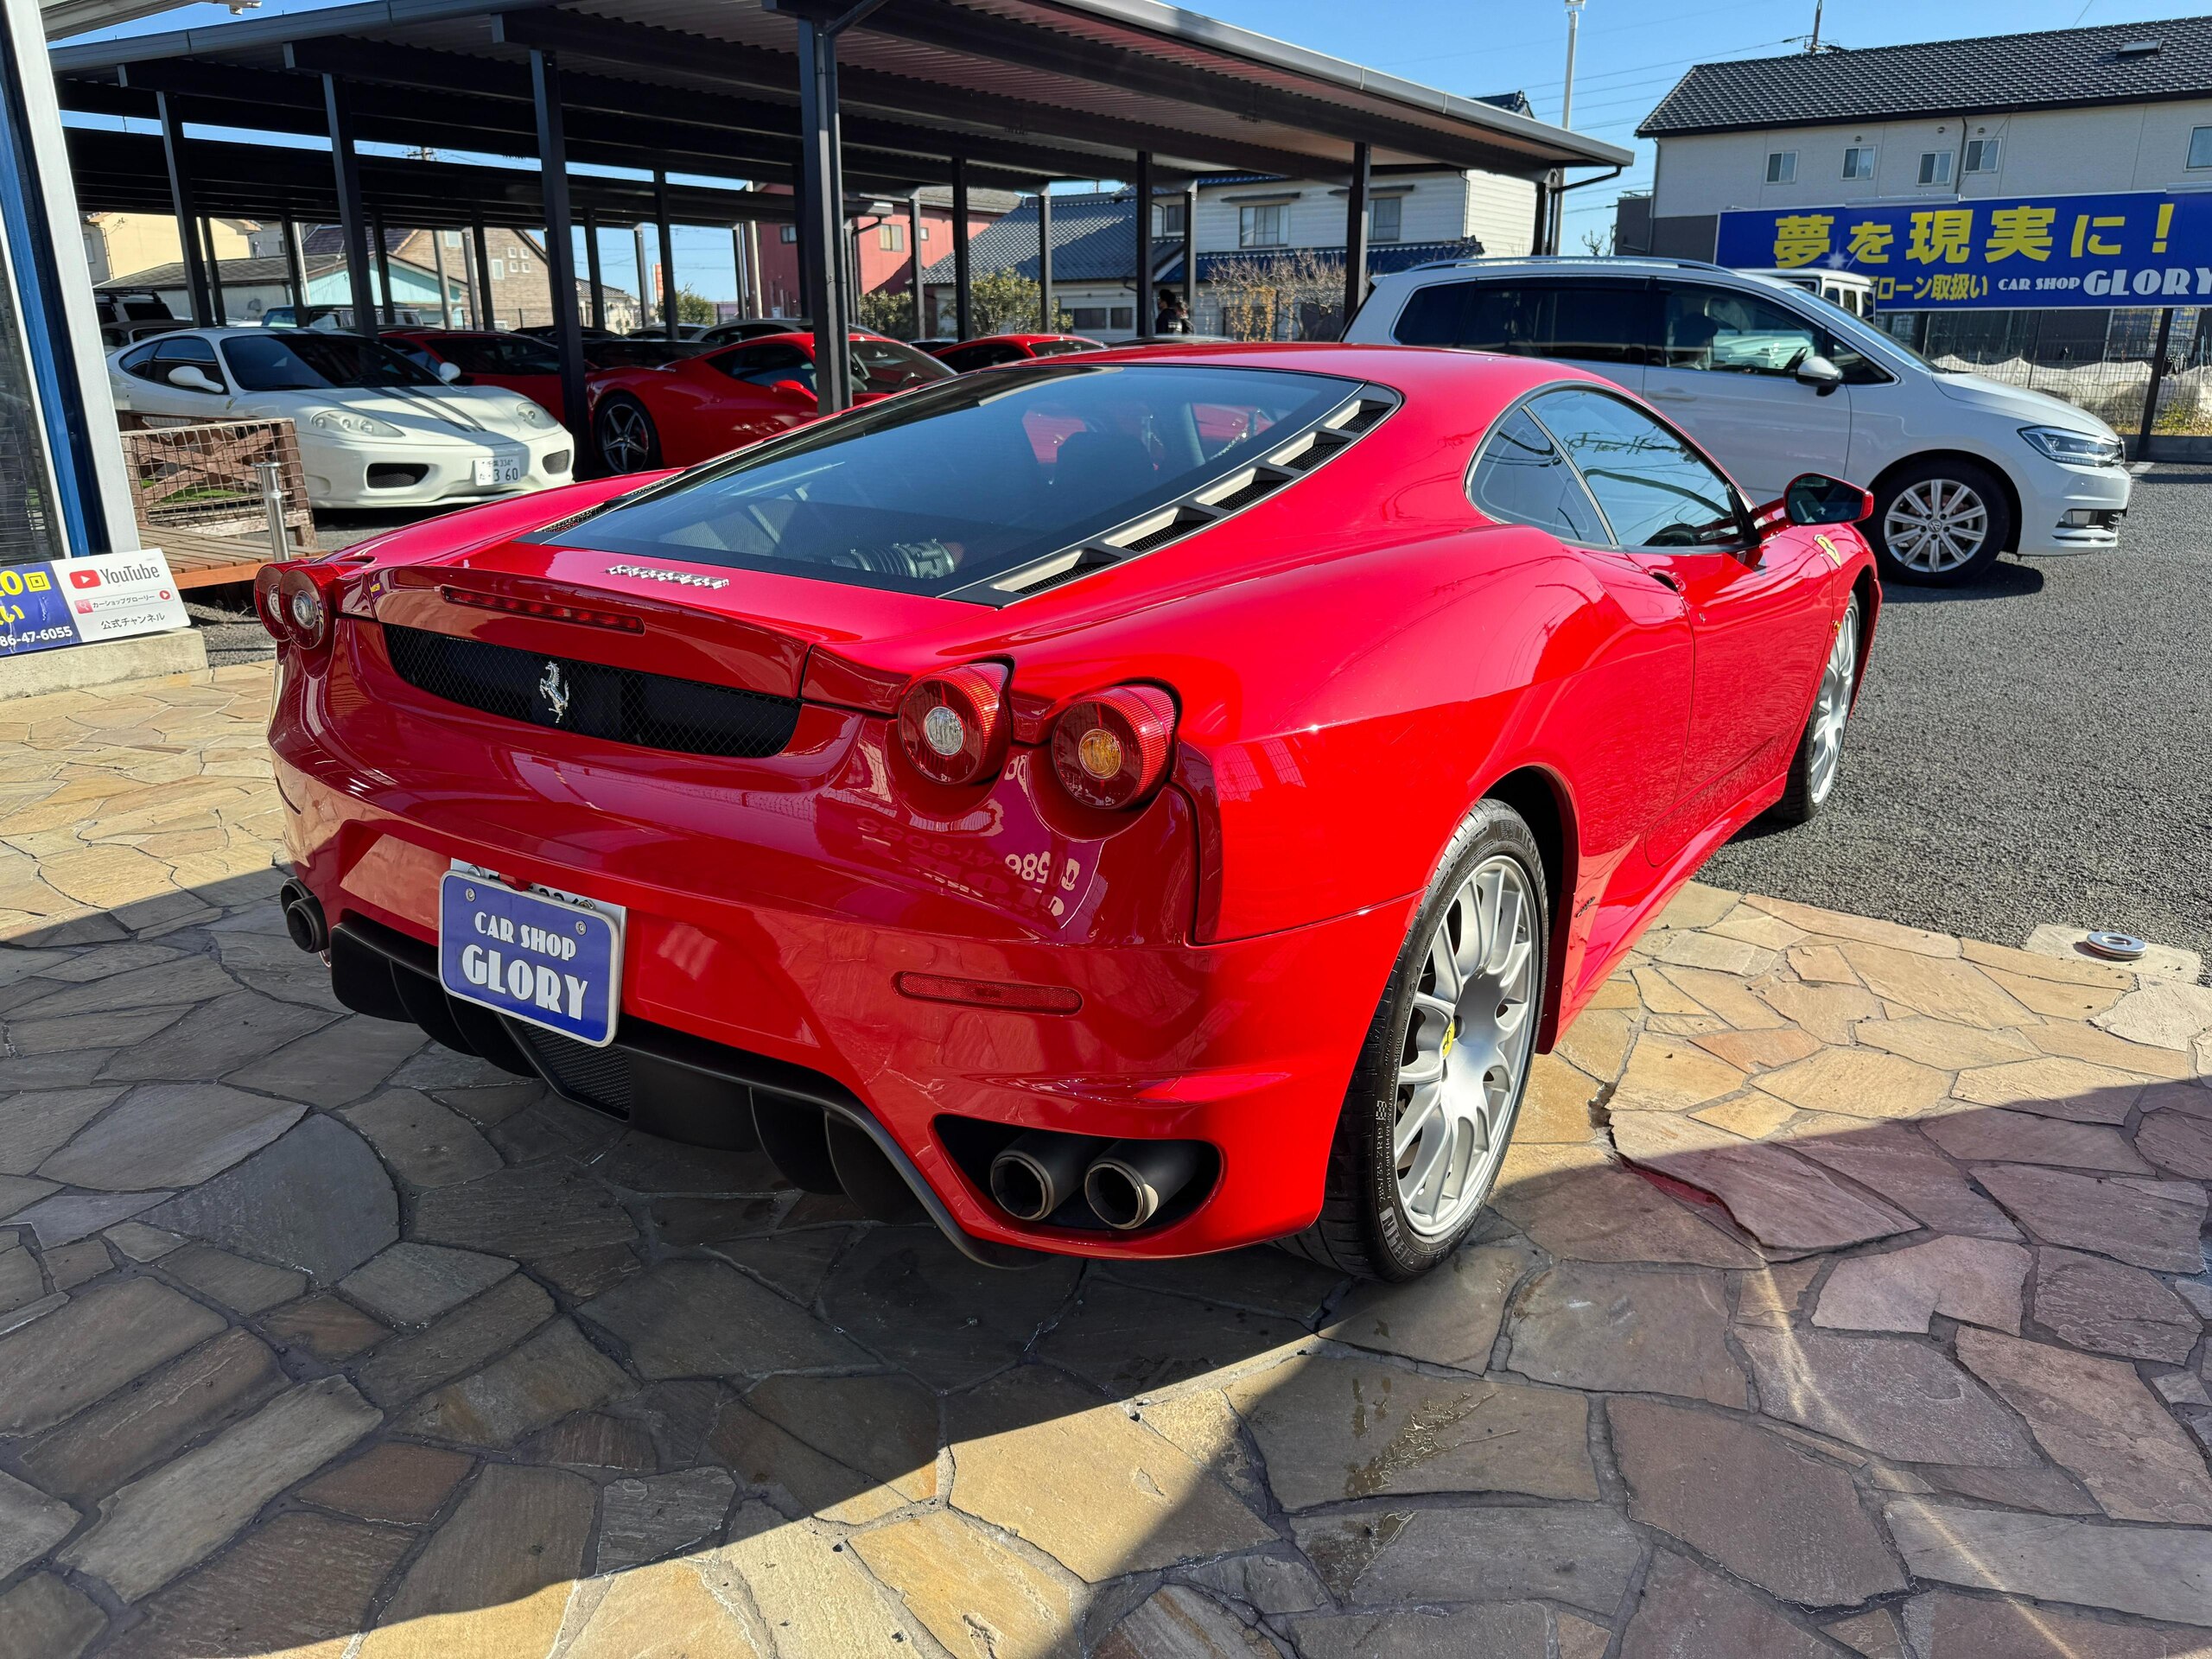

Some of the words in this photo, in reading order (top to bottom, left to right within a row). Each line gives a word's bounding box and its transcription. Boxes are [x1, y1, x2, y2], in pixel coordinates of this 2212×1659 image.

[1867, 272, 1988, 302] ローン取扱い
[1998, 277, 2032, 291] CAR
[2035, 276, 2081, 290] SHOP
[2083, 267, 2212, 296] GLORY
[99, 563, 161, 585] YouTube
[92, 594, 156, 609] カーショップグローリー
[100, 612, 166, 630] 公式チャンネル
[474, 911, 514, 944] CAR
[520, 924, 576, 961] SHOP
[461, 944, 588, 1021] GLORY
